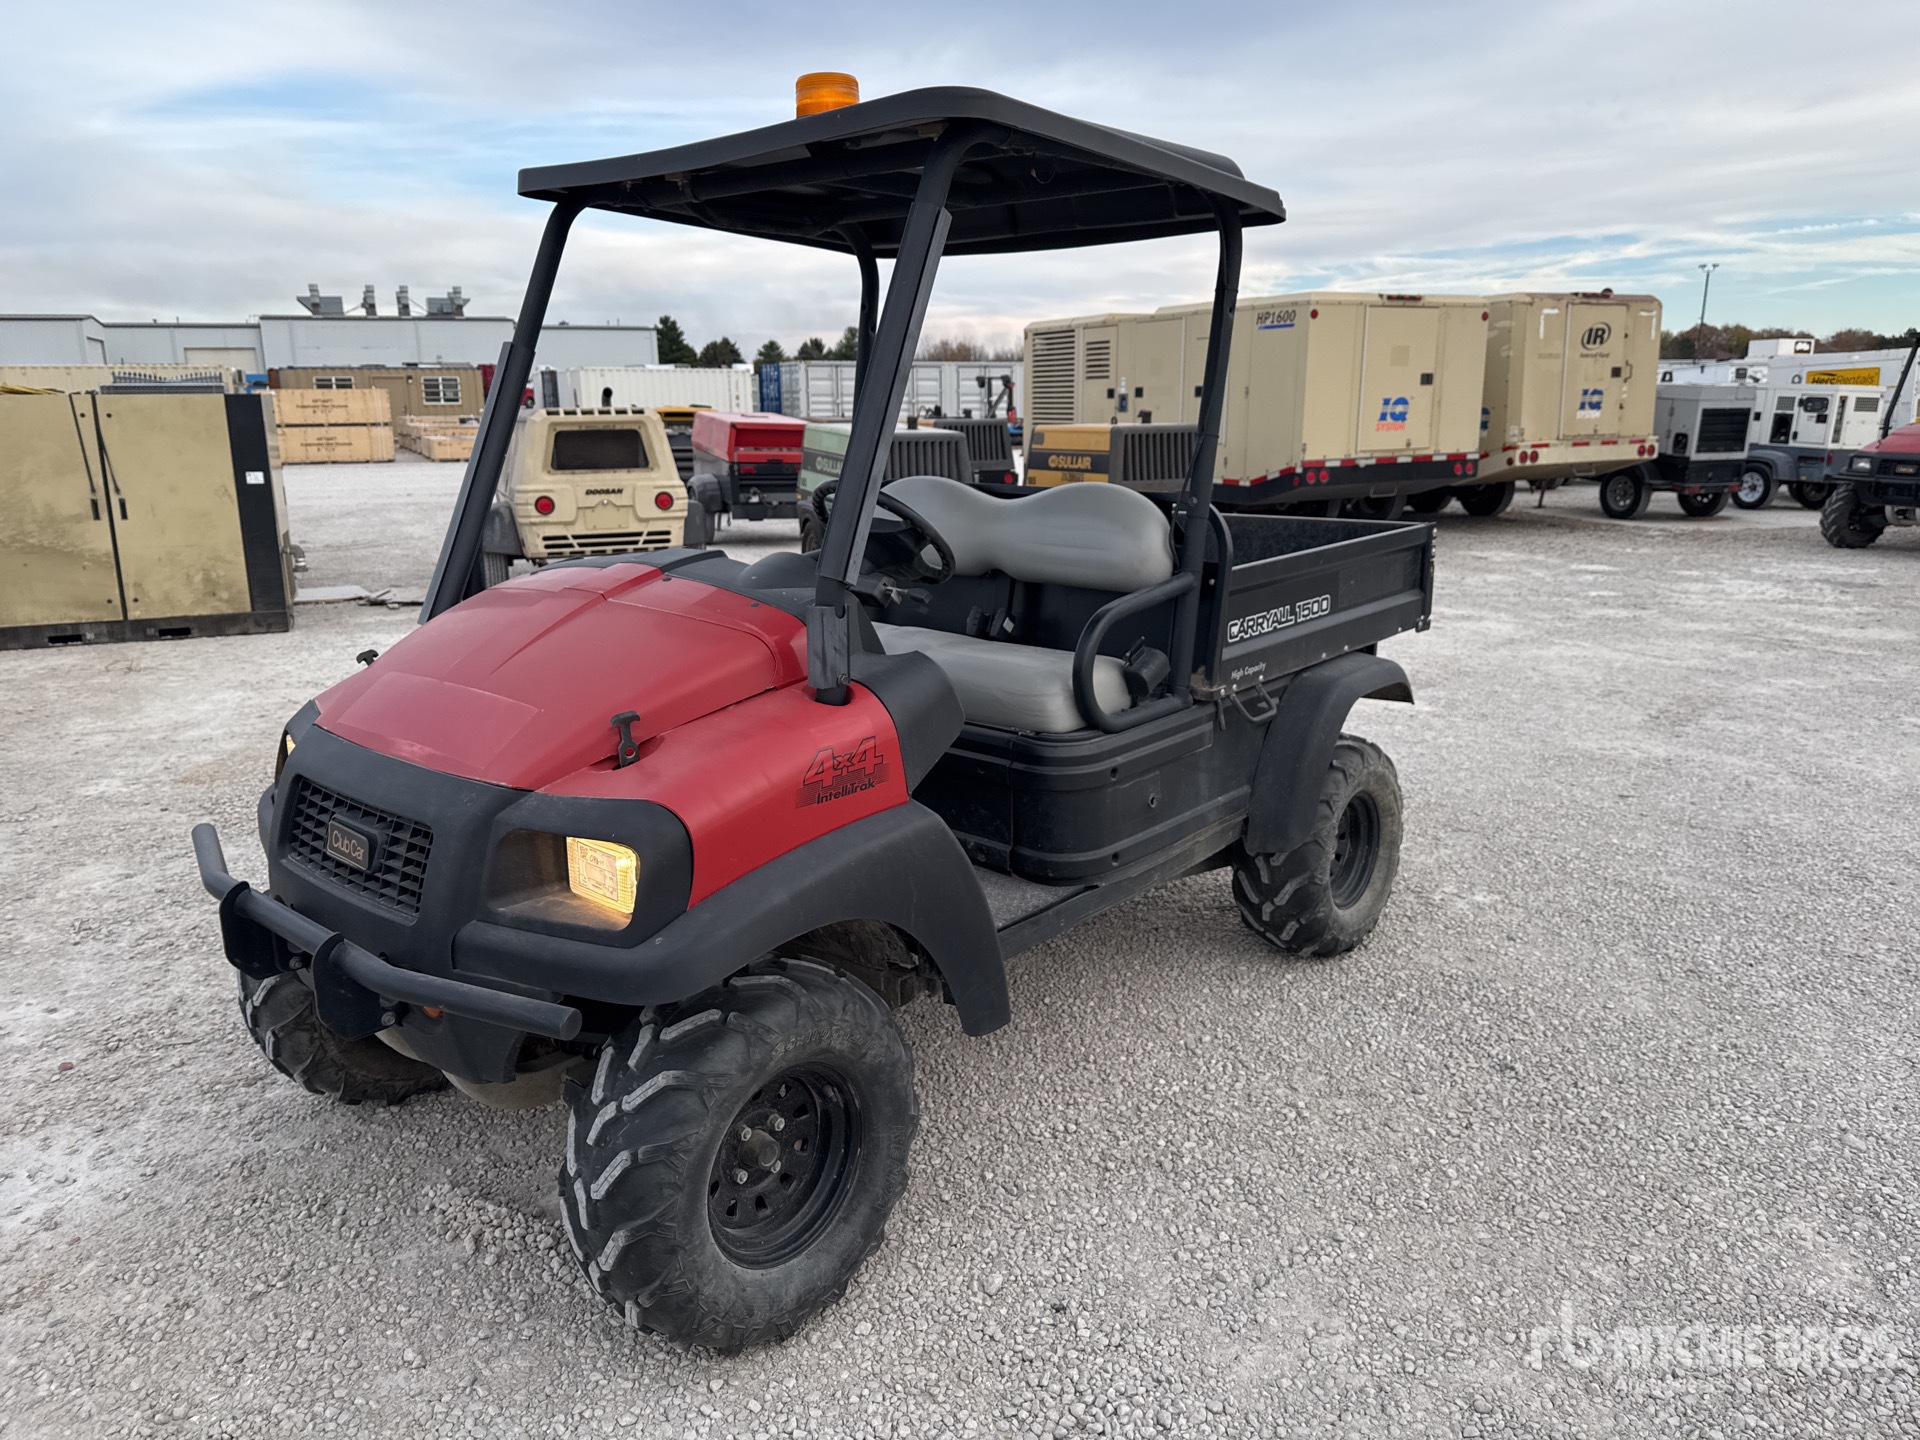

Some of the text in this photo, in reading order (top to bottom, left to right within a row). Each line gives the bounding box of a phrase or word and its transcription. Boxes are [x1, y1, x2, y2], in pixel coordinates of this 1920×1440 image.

[1256, 309, 1297, 326] HP1600
[1586, 326, 1606, 345] IR
[1378, 396, 1409, 423] IQ
[1578, 388, 1605, 410] IQ
[1057, 455, 1092, 470] SULLAIR
[585, 488, 624, 496] DOOSAN
[1227, 594, 1331, 643] CARRYALL 1500
[1231, 661, 1267, 680] High Capacity
[803, 736, 884, 789] 4x4
[816, 778, 876, 805] IntelliTrak
[332, 830, 365, 860] Club Car
